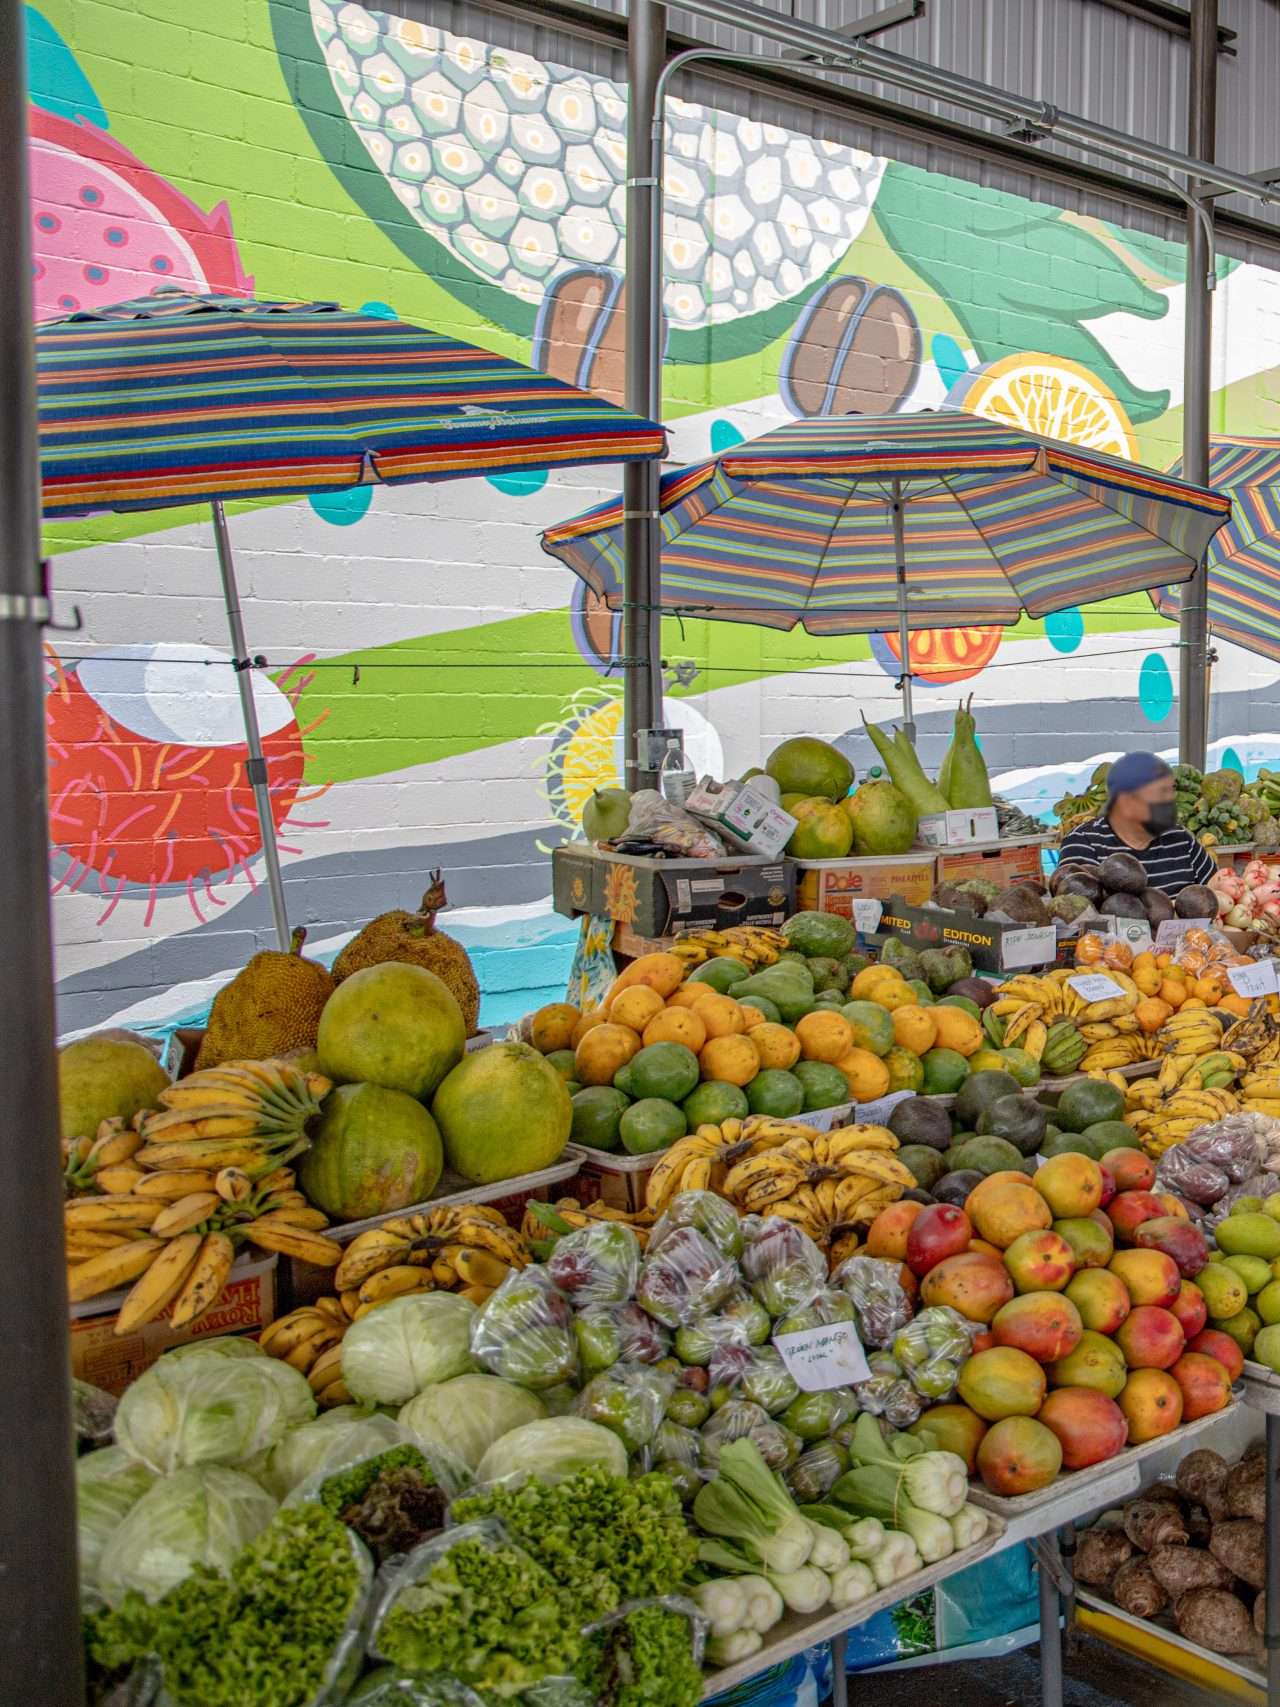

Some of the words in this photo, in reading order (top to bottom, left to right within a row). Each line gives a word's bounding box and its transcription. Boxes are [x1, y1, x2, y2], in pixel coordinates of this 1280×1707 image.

[825, 872, 863, 889] Dole
[880, 915, 912, 930] MITED
[943, 928, 992, 946] EDITION
